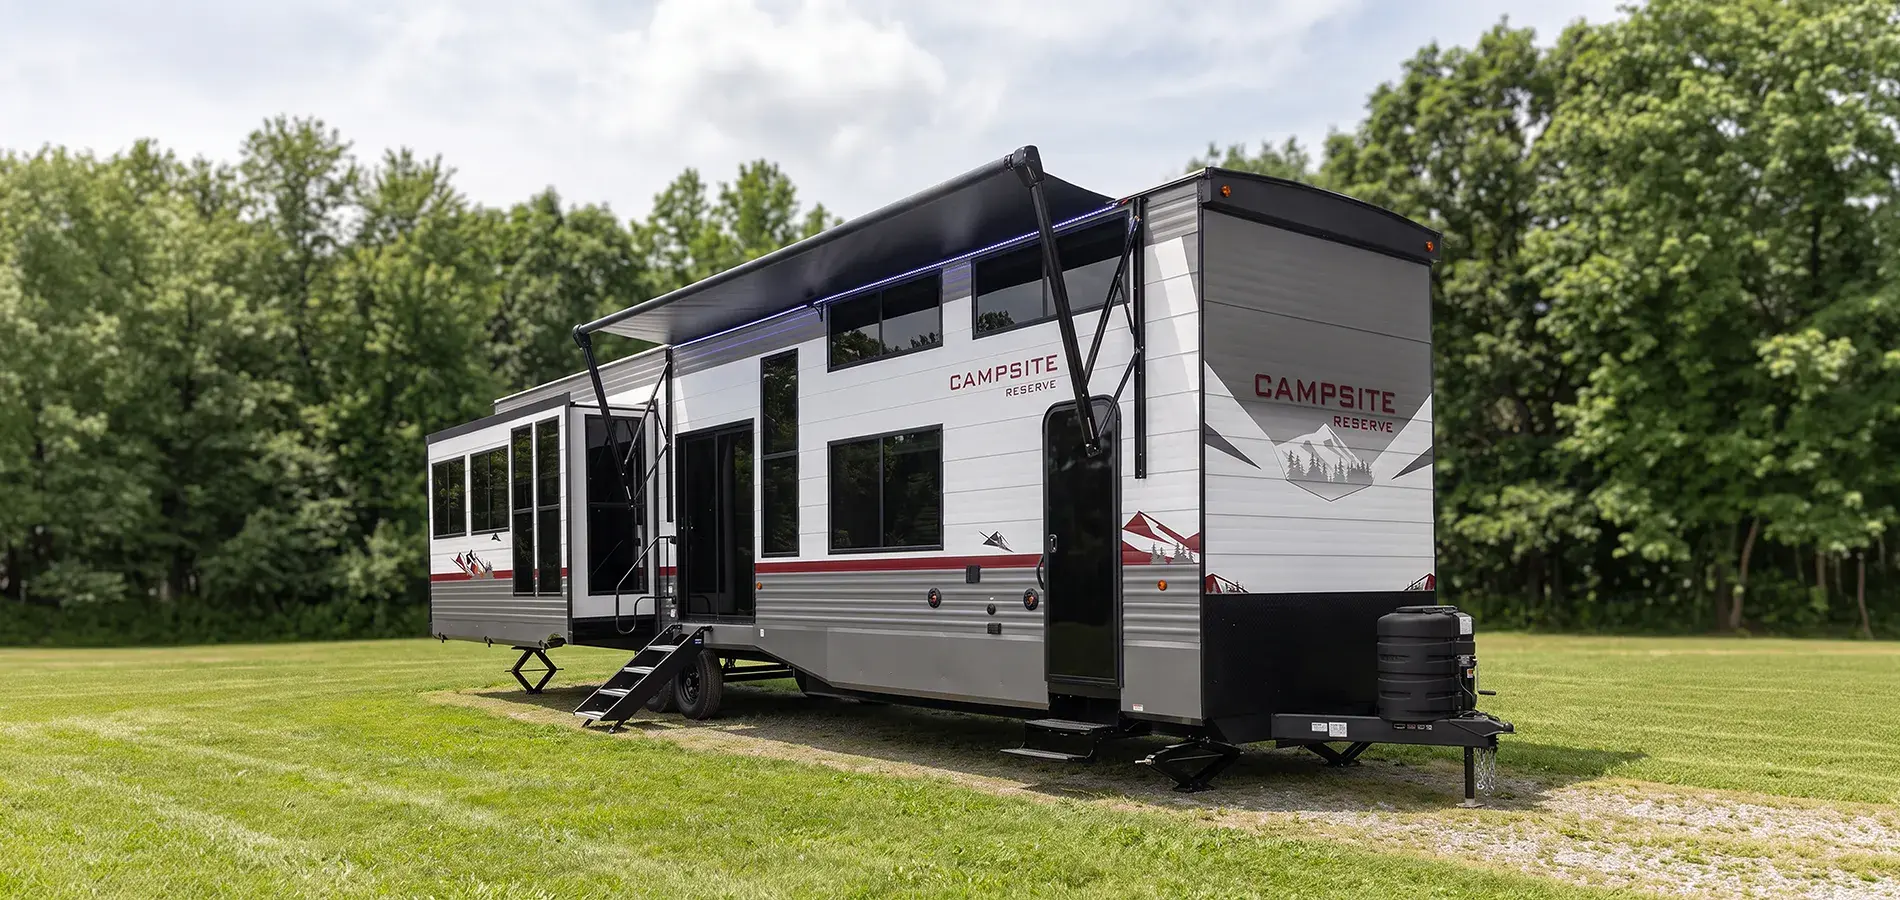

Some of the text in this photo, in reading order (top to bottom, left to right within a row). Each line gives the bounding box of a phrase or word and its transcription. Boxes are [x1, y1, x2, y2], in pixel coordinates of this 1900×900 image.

[950, 354, 1058, 391] CAMPSITE
[1005, 379, 1056, 397] RESERVE
[1254, 373, 1396, 414] CAMPSITE
[1333, 415, 1393, 433] RESERVE
